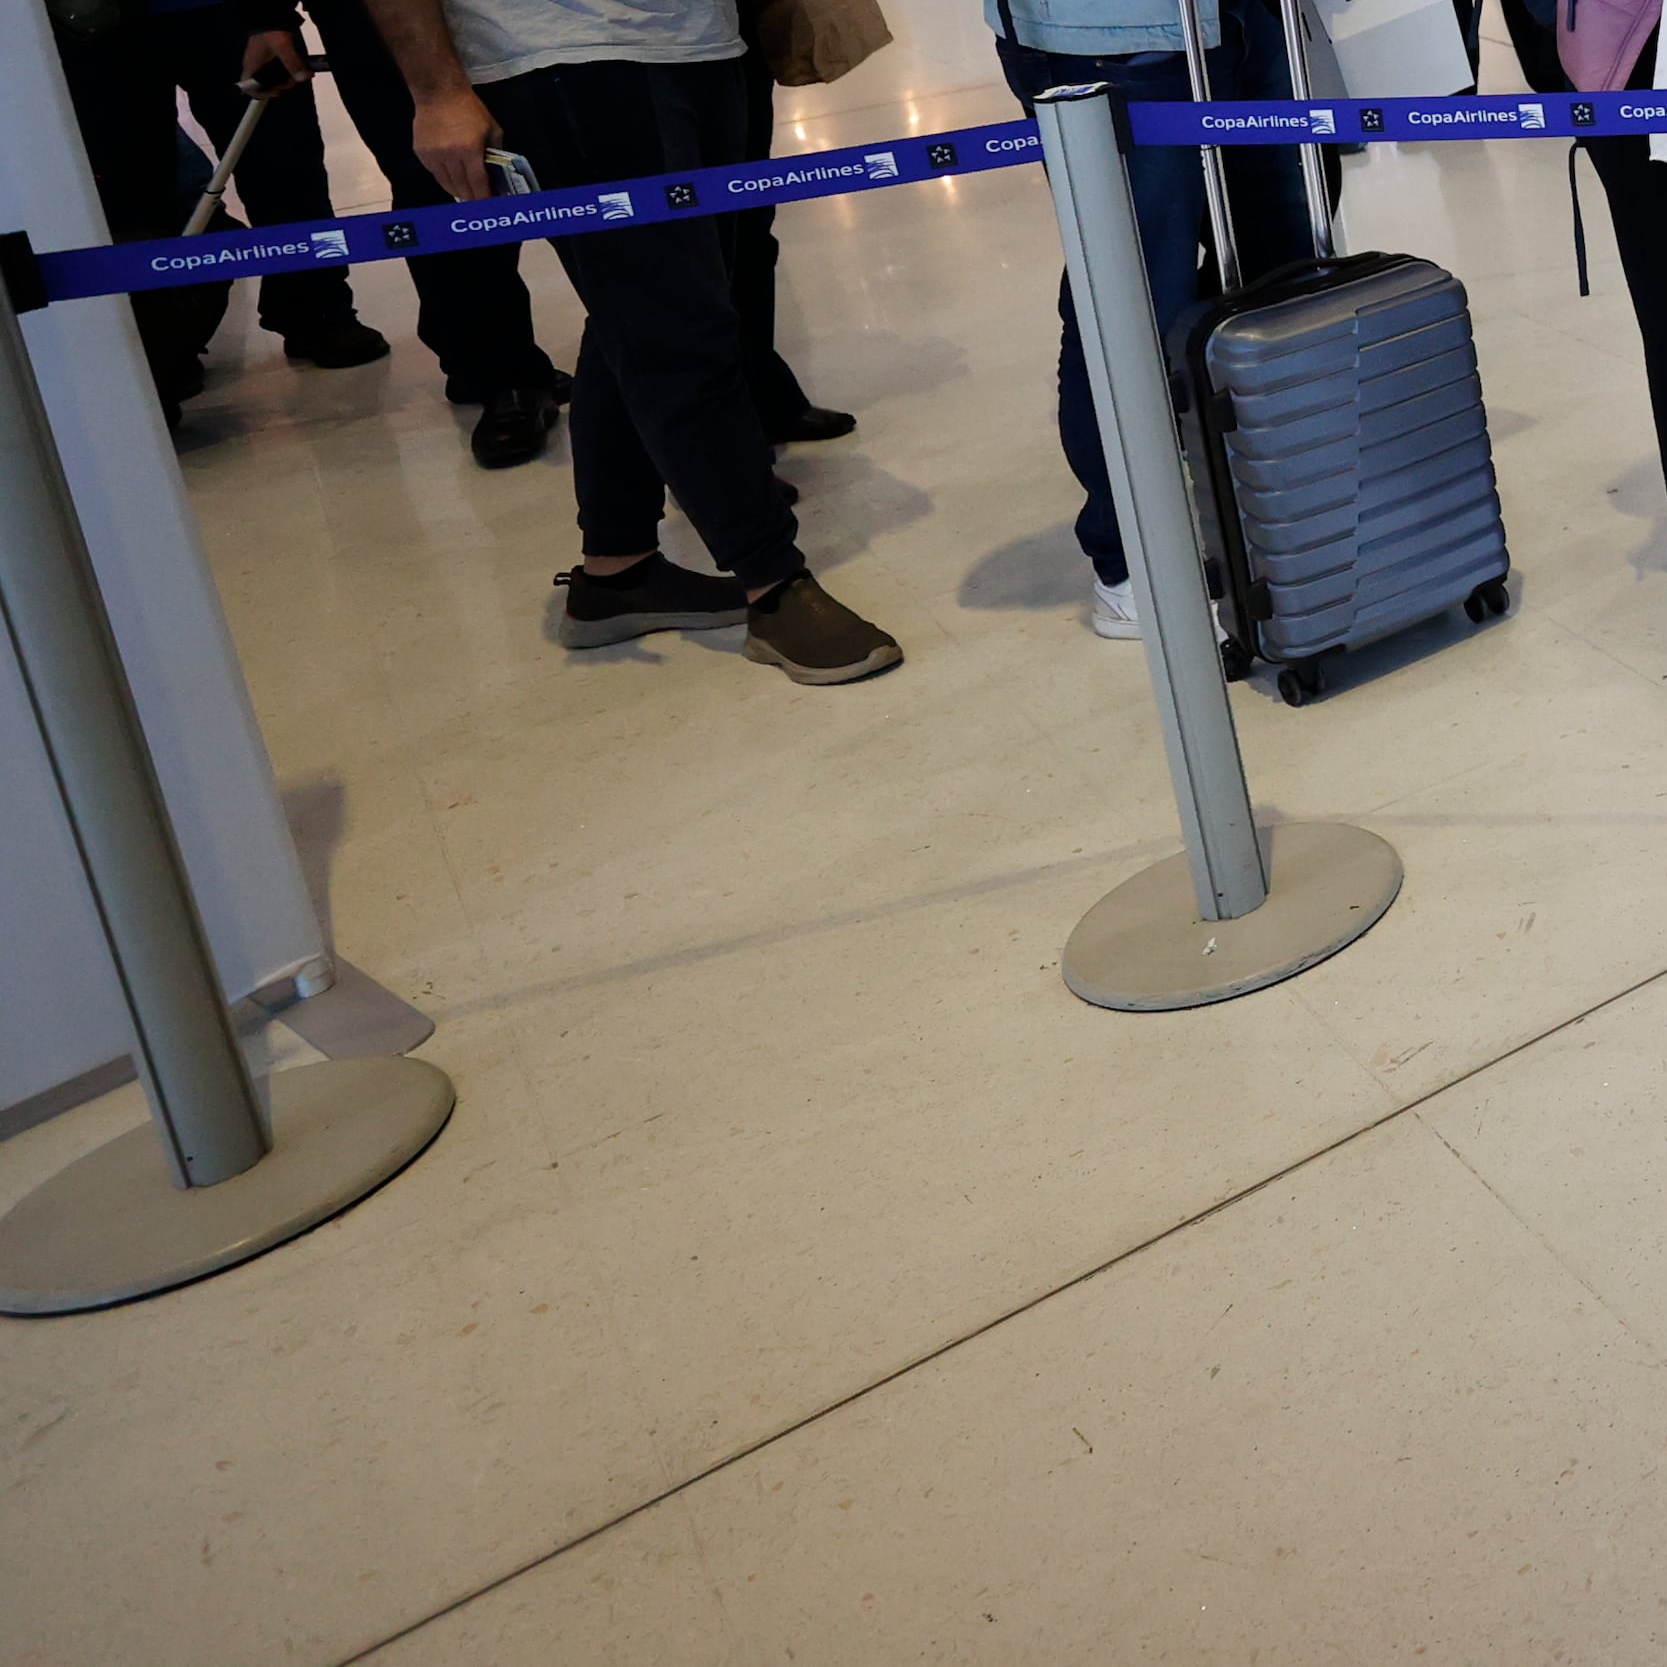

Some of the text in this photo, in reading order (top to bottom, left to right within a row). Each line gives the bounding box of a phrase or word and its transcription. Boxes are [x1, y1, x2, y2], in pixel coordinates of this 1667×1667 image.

[1201, 113, 1309, 132] CopaAirlines
[1408, 108, 1518, 127] CopaAirlines
[985, 135, 1041, 155] Copa
[727, 160, 864, 195] CopaAirlines
[450, 200, 597, 234] CopaAirlines
[151, 239, 310, 273] CopaAirlines
